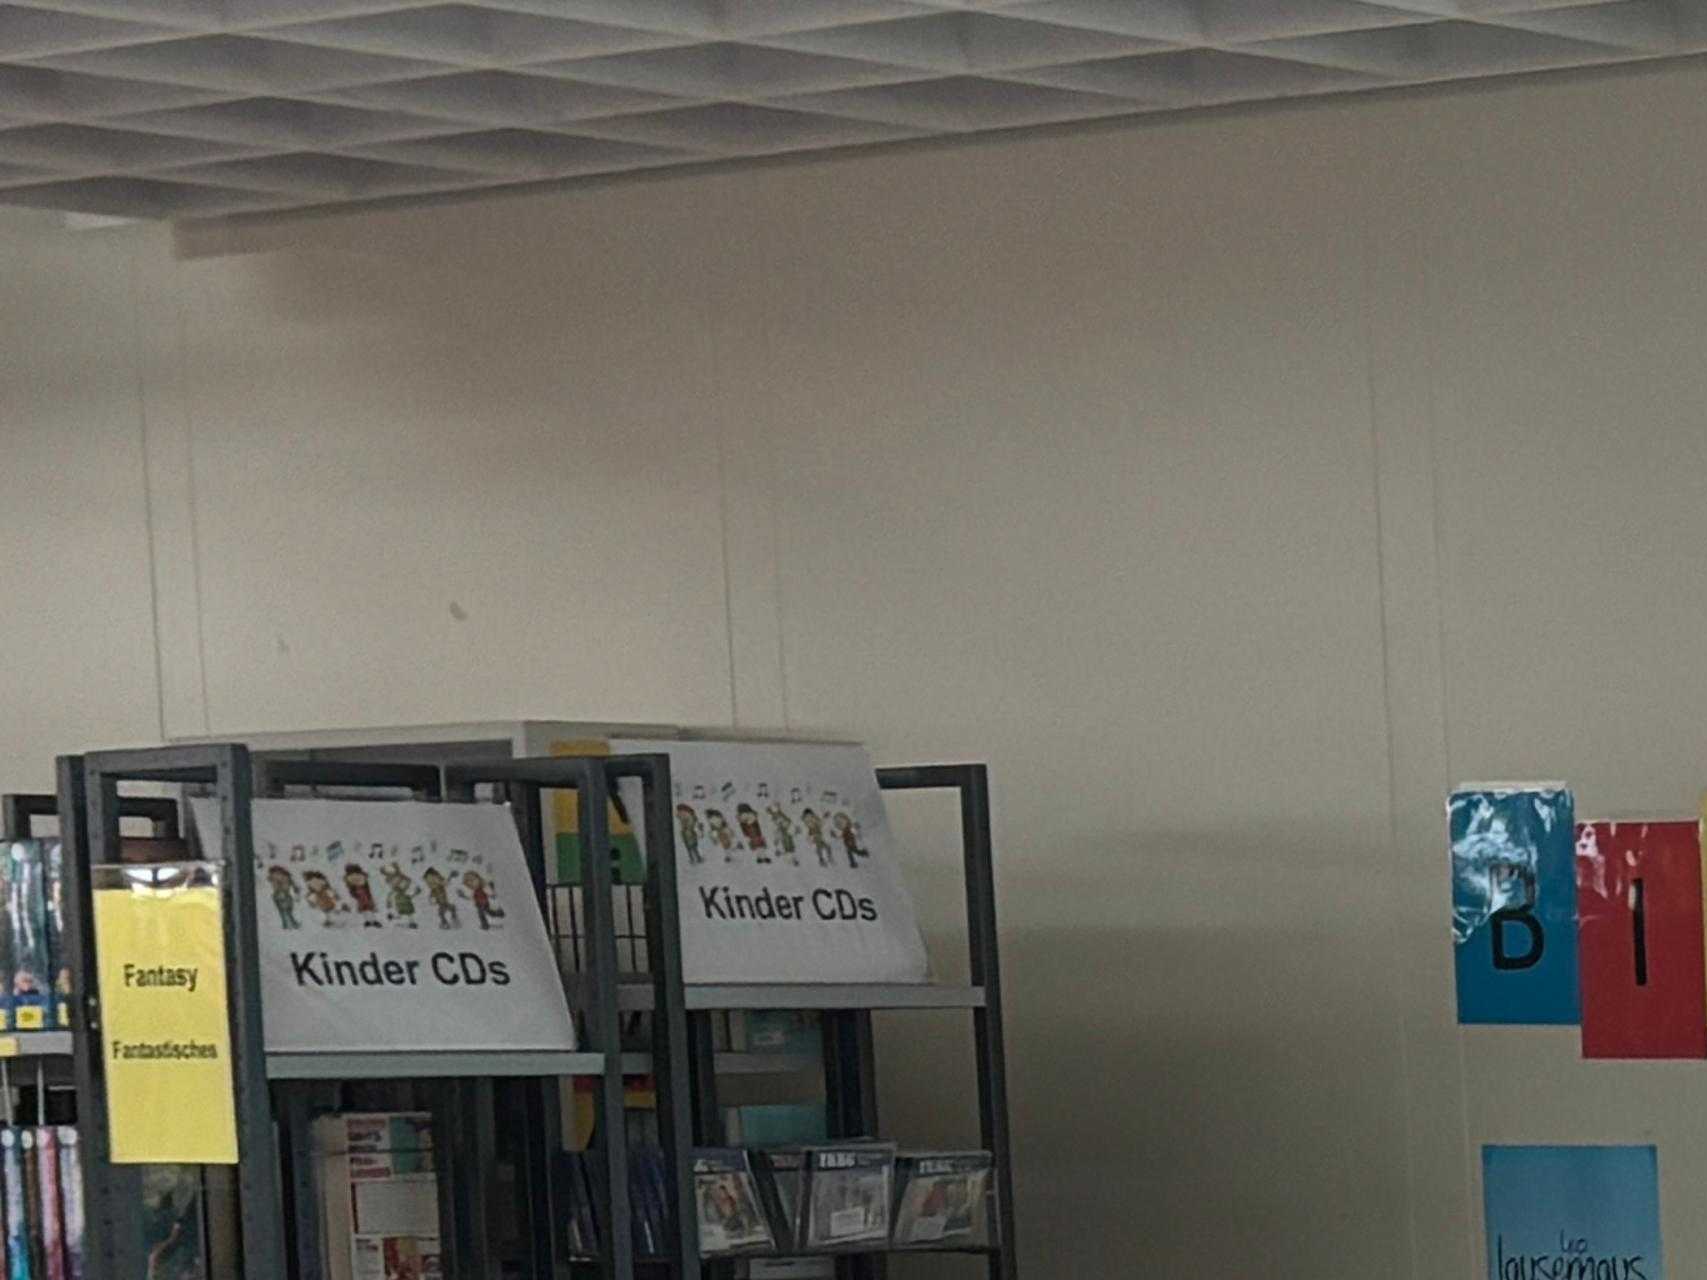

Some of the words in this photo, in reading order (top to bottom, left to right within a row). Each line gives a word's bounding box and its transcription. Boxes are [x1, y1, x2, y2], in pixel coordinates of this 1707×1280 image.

[699, 885, 804, 919] Kinder
[812, 888, 878, 921] CDs
[124, 963, 198, 991] Fantasy
[290, 951, 420, 986] Kinder
[431, 951, 511, 986] CDs
[113, 1040, 218, 1060] Fantastisches
